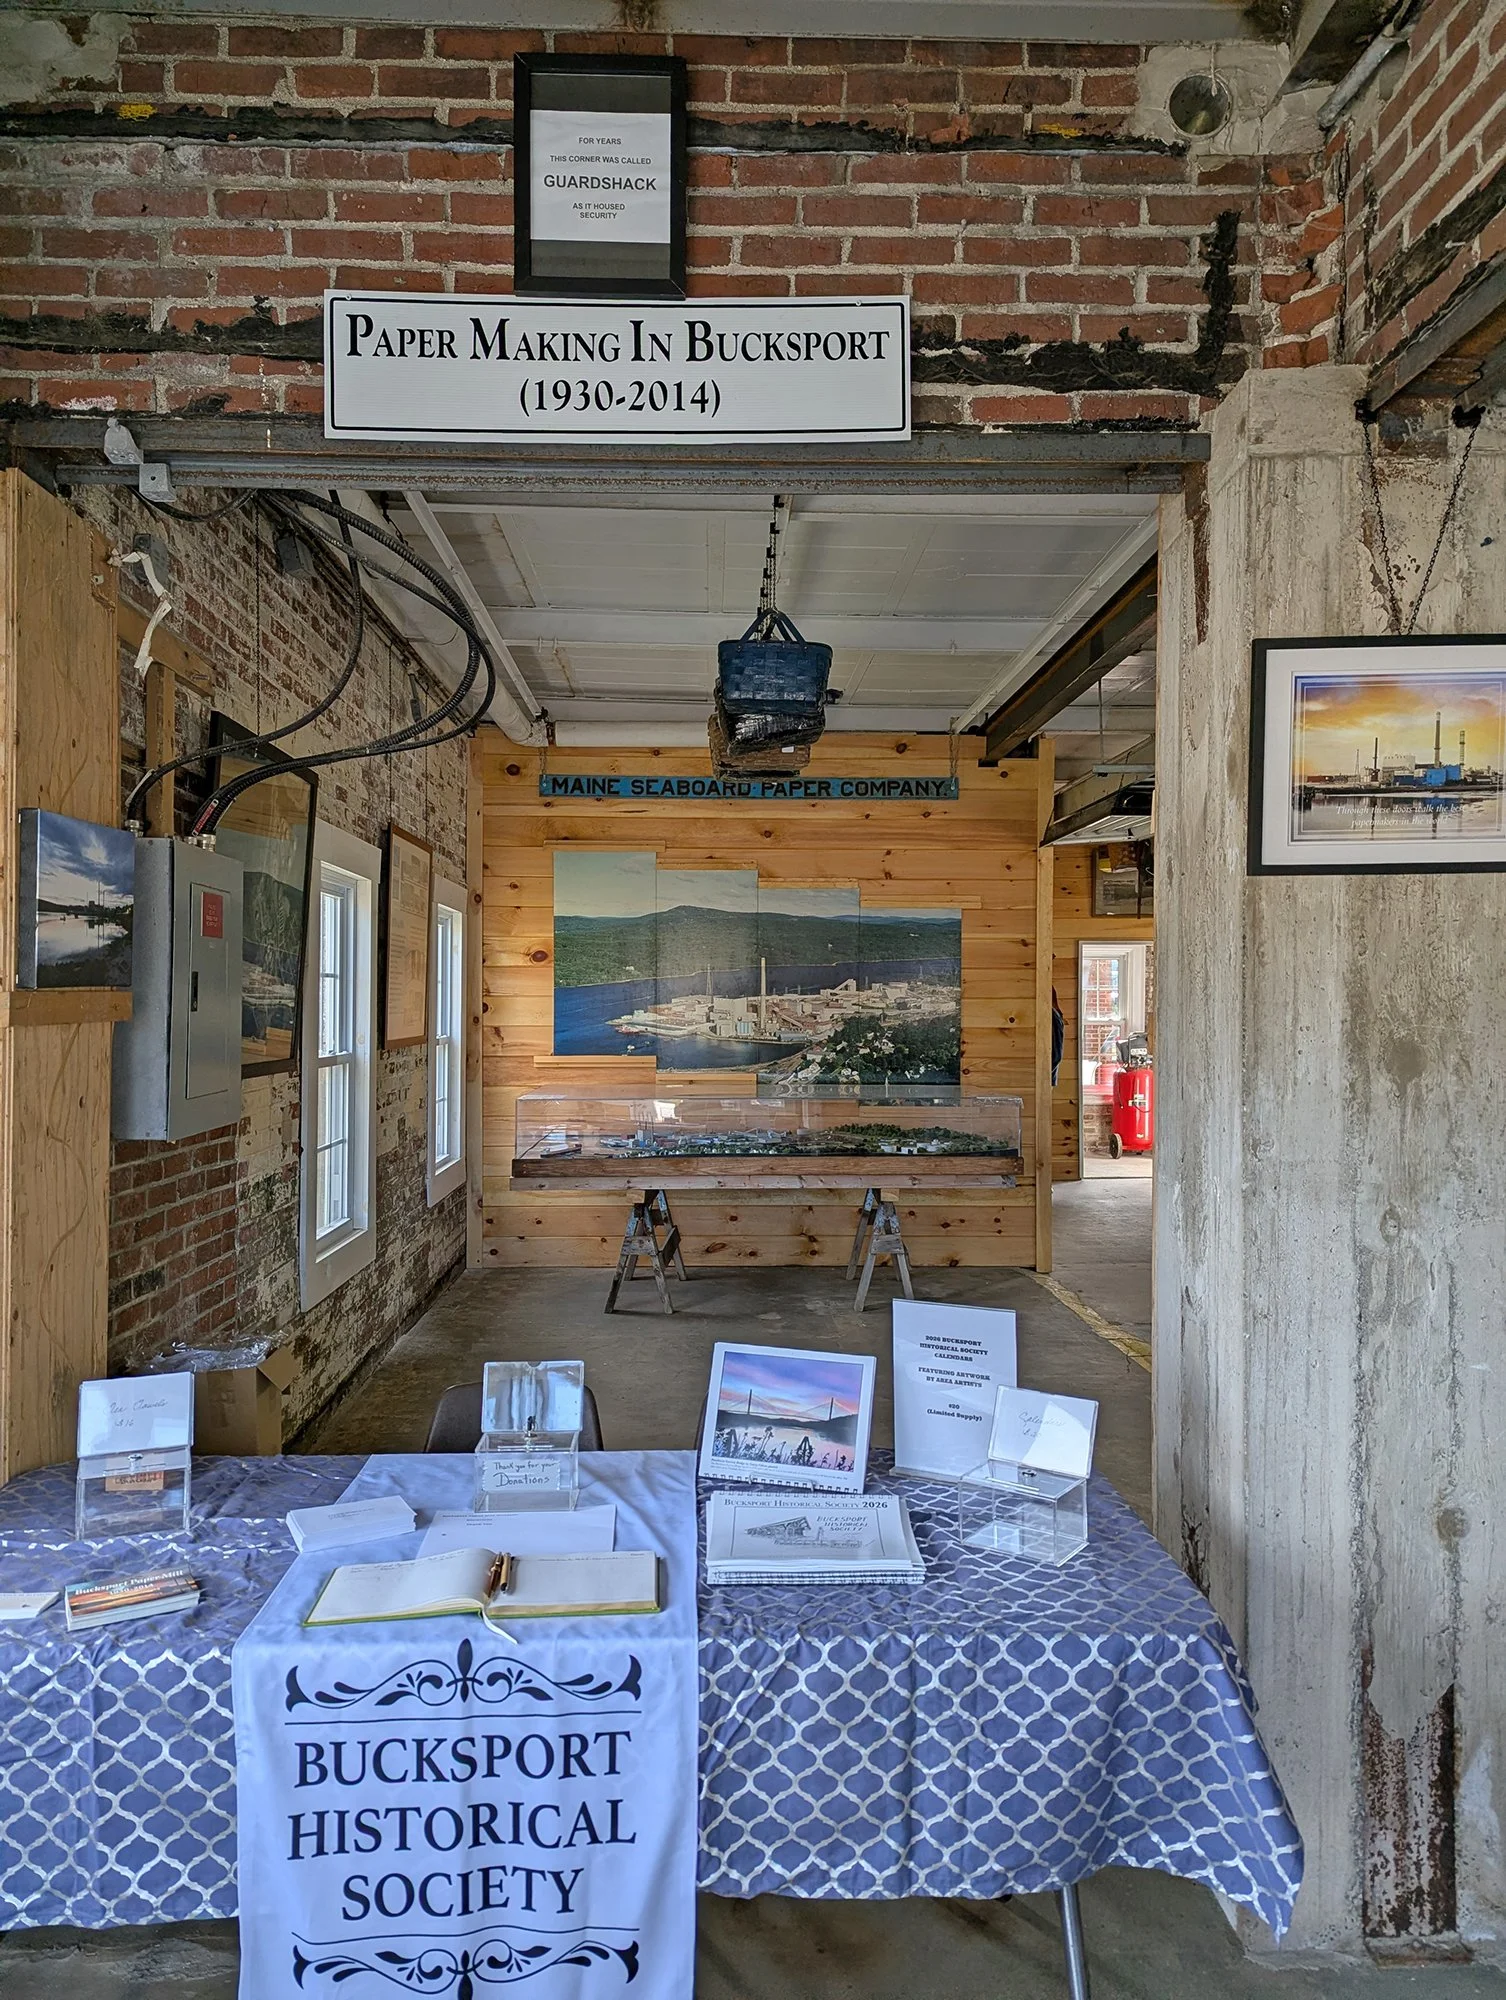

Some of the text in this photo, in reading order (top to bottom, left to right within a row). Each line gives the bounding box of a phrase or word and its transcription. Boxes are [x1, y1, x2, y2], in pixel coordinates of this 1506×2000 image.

[579, 137, 594, 145] FOR
[569, 155, 600, 163] CORNER
[602, 156, 619, 164] WAS
[621, 157, 651, 165] CALLED
[544, 174, 656, 191] GUARDSHACK
[573, 202, 625, 211] AS IT HOUSED
[580, 211, 617, 219] SECURITY
[346, 313, 890, 363] PAPER MAKING IN BUCKSPORT
[519, 378, 721, 418] (1930-2014)
[551, 777, 622, 795] MAINE
[631, 778, 751, 797] SEABOARD
[761, 780, 832, 797] PAPER
[1336, 803, 1465, 815] Through these doors walk the best
[1350, 818, 1398, 829] papermakers
[1411, 817, 1424, 825] the
[1428, 816, 1449, 825] world
[942, 1337, 982, 1347] BUCKSPORT
[919, 1343, 988, 1356] HISTORICAL SOCIETY
[934, 1352, 973, 1362] CALENDARS
[918, 1366, 991, 1381] FEATURING ARTWORK
[936, 1376, 953, 1384] AREA
[954, 1379, 982, 1388] ARTISTS
[927, 1408, 983, 1422] (Limited Supply)
[493, 1461, 559, 1472] Thank you for your
[493, 1472, 550, 1488] Donations
[724, 1498, 888, 1509] BUCKSPORT HISTORICAL SOCIETY 2026
[816, 1515, 868, 1523] BUCKSPORT
[75, 1569, 184, 1596] Bucksport Paper Mill
[294, 1731, 632, 1788] BUCKSPORT
[287, 1799, 637, 1860] HISTORICAL
[342, 1865, 584, 1921] SOCIETY
